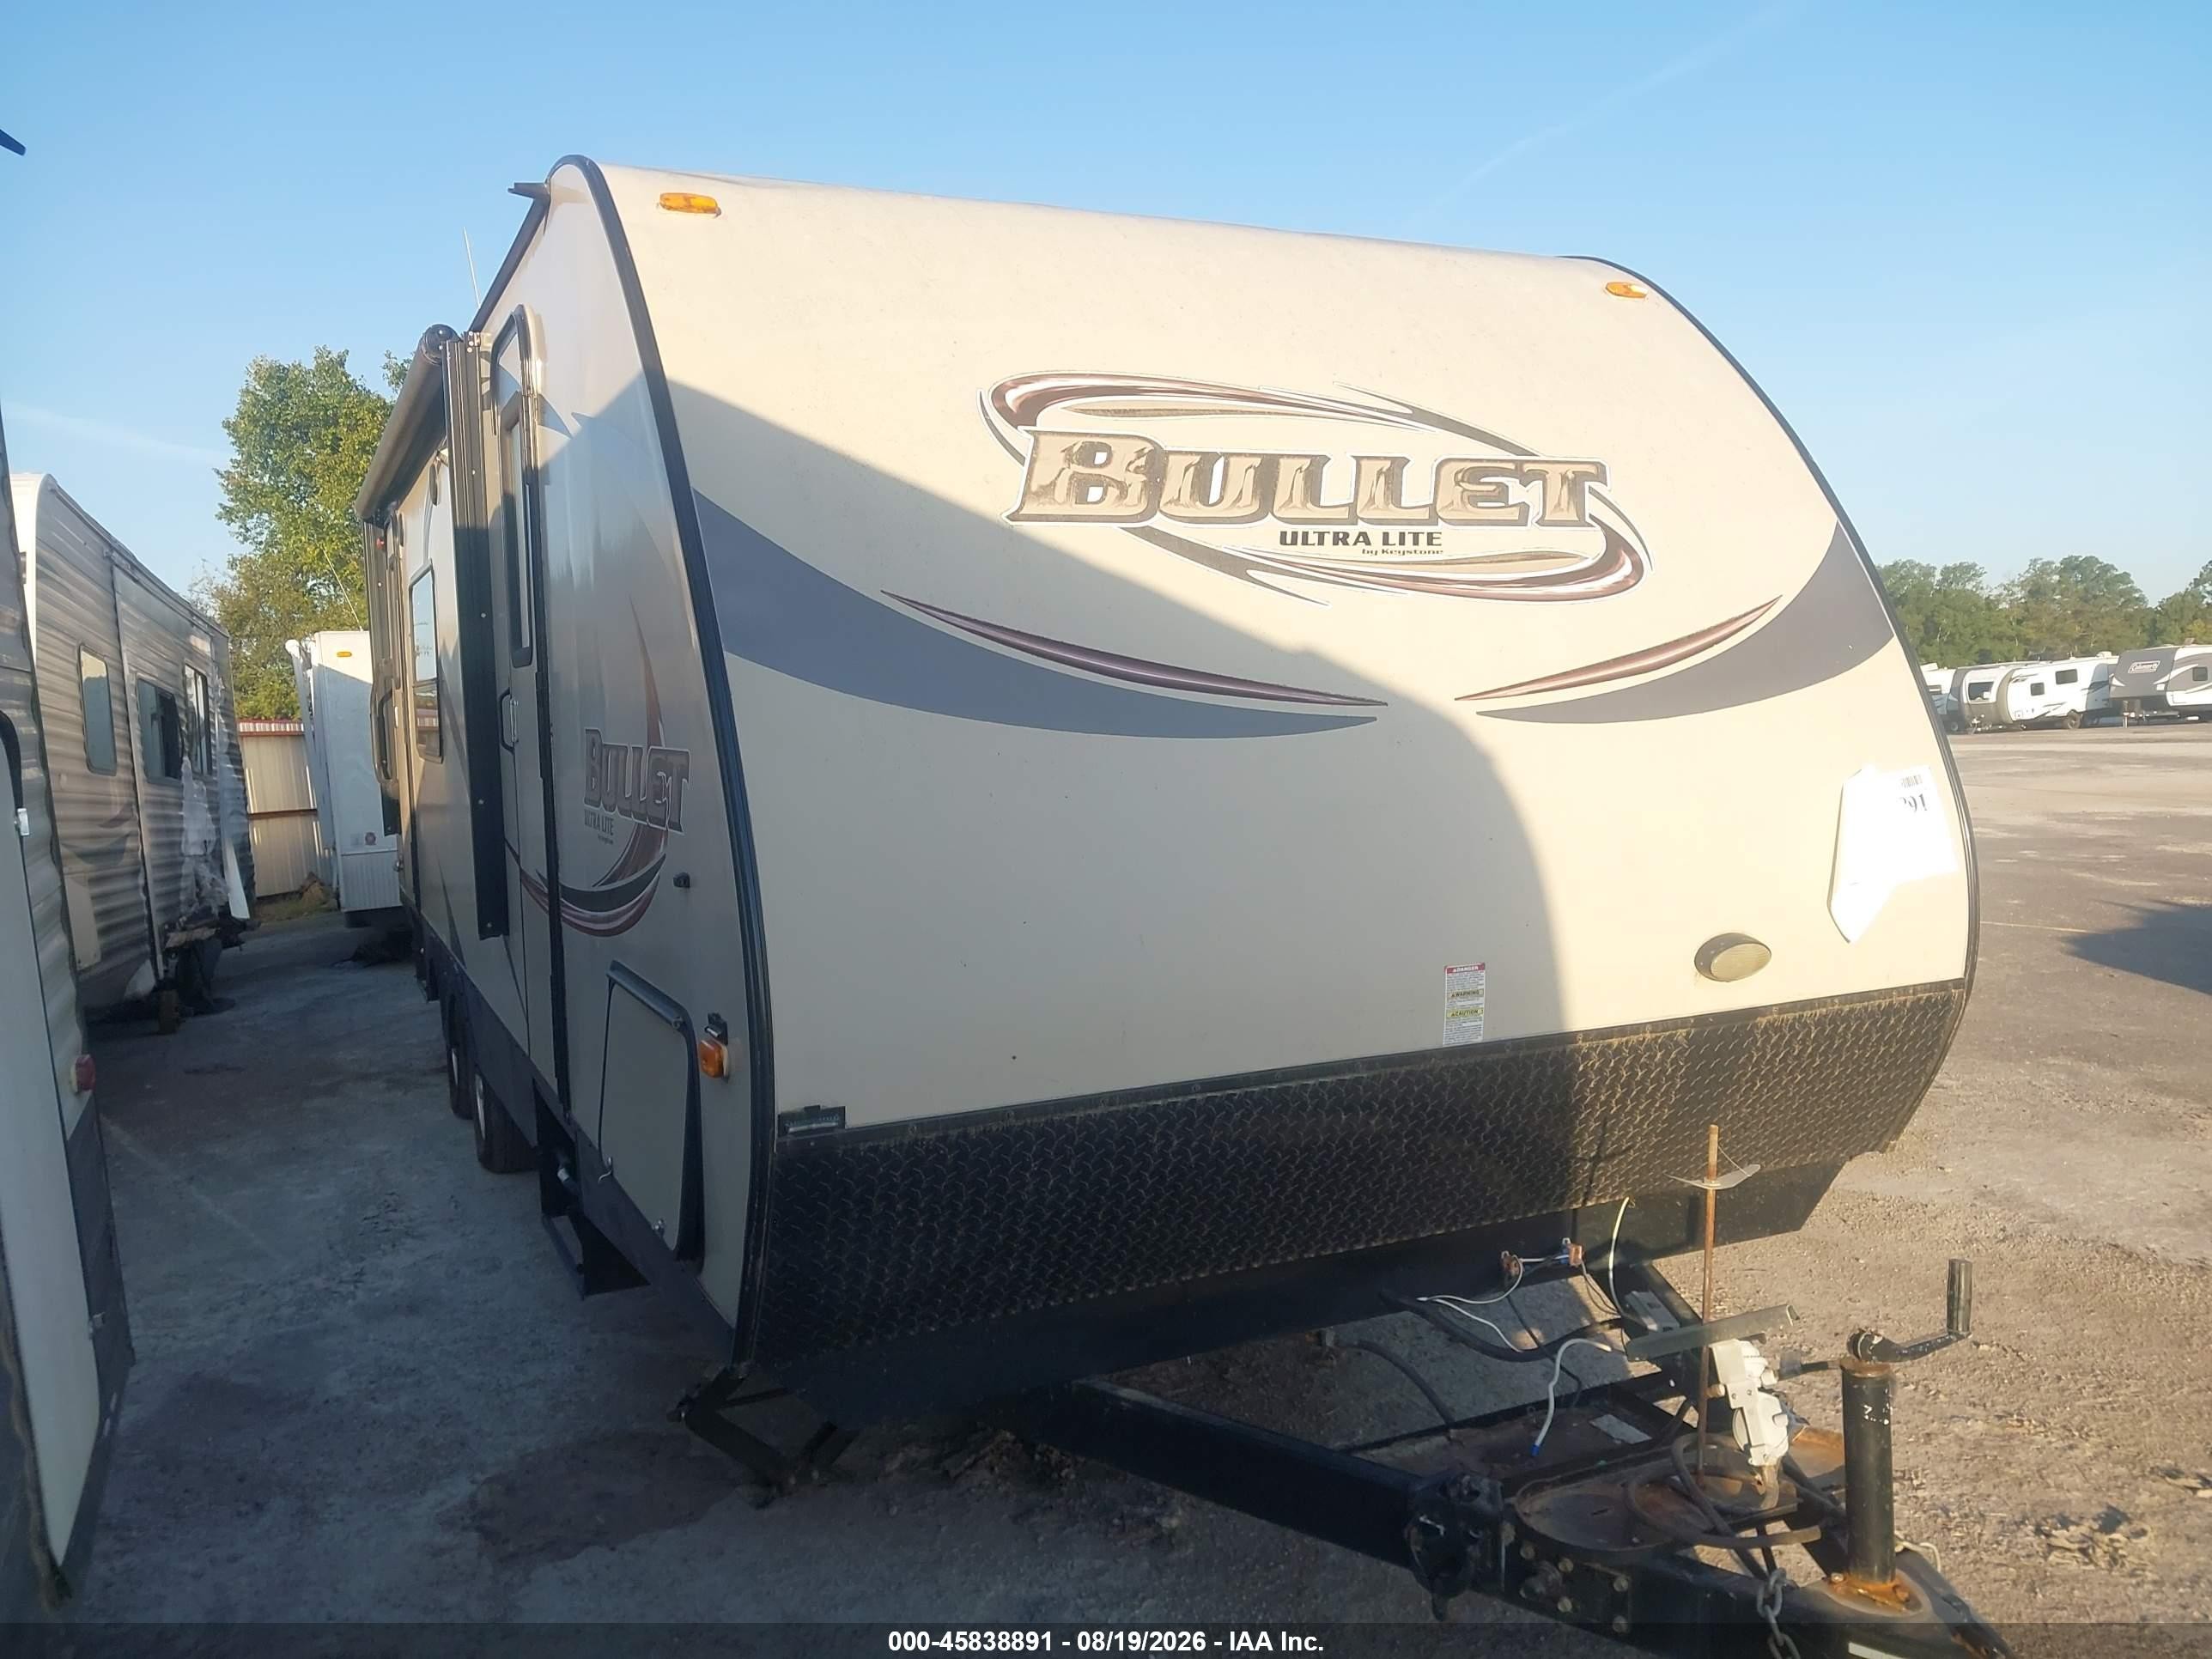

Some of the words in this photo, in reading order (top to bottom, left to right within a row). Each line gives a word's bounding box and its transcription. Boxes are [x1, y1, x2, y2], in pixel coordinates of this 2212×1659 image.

[1006, 428, 1609, 527] BULLET
[1279, 530, 1372, 546] ULTRA
[1382, 531, 1443, 546] LITE
[1361, 548, 1378, 556] by
[585, 728, 690, 835] BULLET
